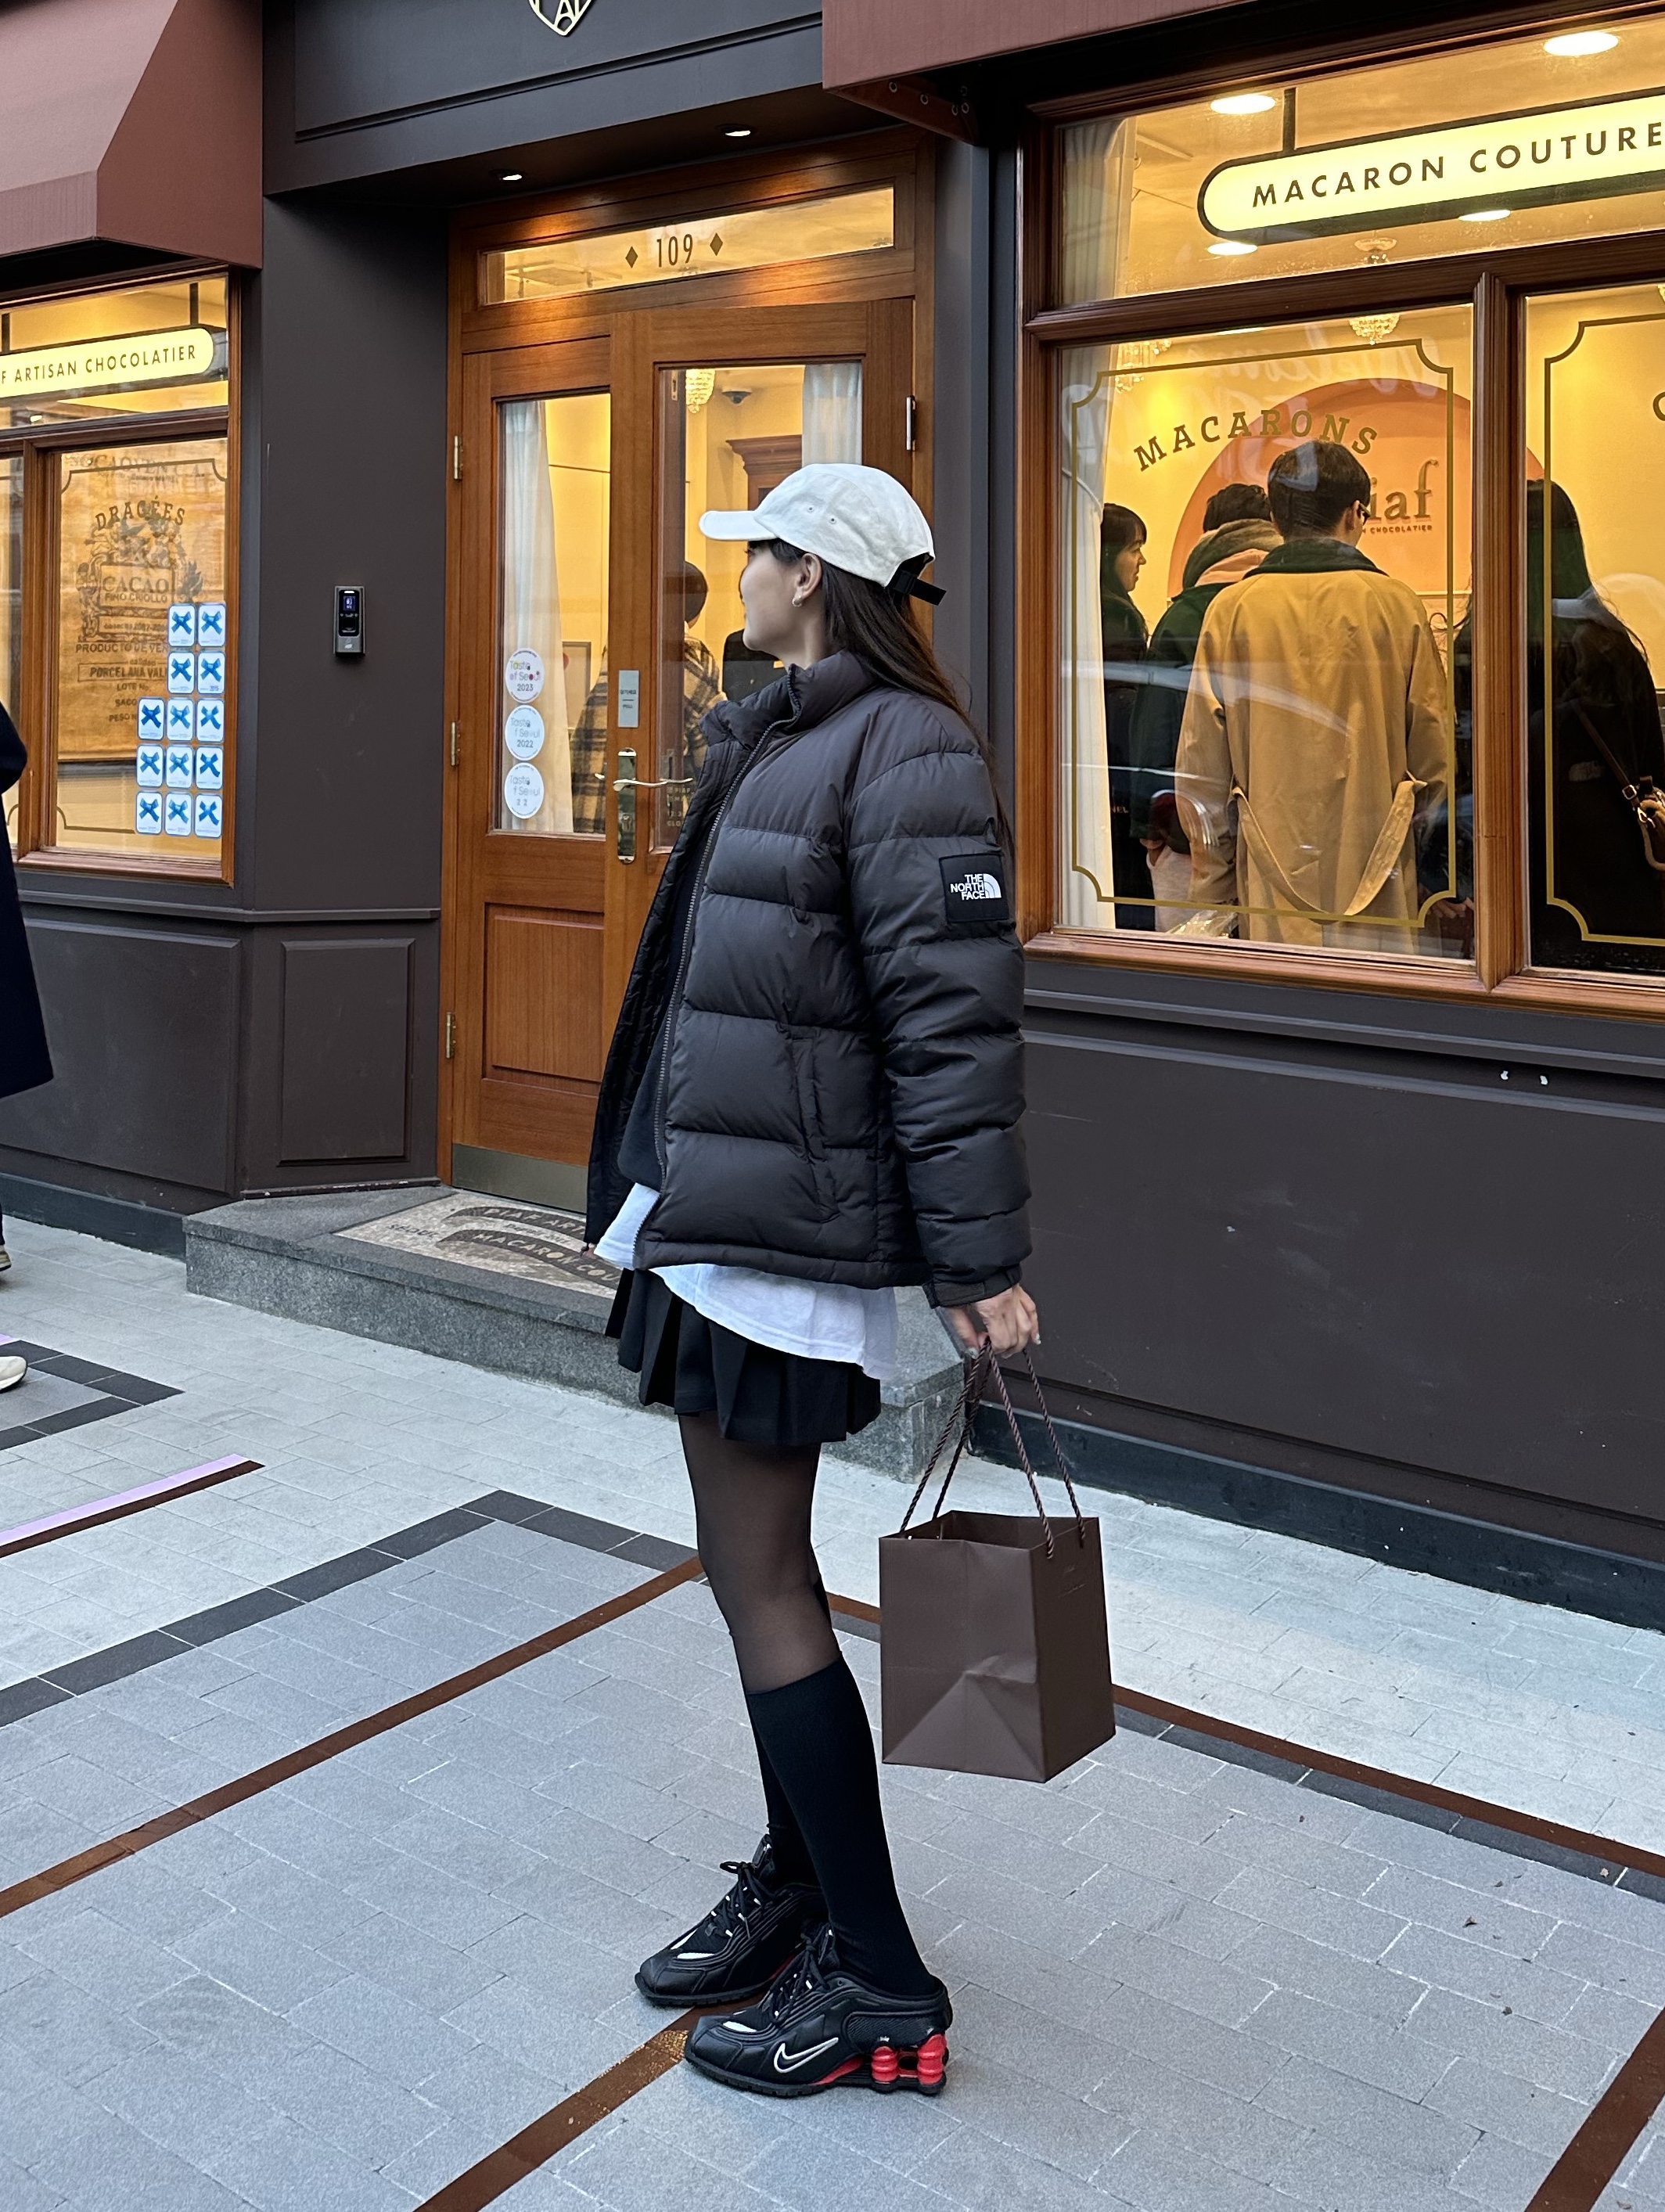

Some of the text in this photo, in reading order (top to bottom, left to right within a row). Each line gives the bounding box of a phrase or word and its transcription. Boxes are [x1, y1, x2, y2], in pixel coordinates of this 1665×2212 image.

[1252, 121, 1663, 208] MACARON COUTURE
[656, 234, 693, 268] 109
[2, 344, 196, 384] F ARTISAN CHOCOLATIER
[1133, 409, 1379, 472] MACARONS
[1368, 459, 1439, 520] iaf
[95, 495, 185, 531] DRAGÉES
[1369, 524, 1433, 534] CHOCOLATIER
[102, 576, 169, 593] CACAO
[75, 643, 132, 654] PRODUCTO
[117, 682, 136, 691] LOTE
[517, 683, 534, 692] 2023
[516, 739, 534, 748] 2022
[964, 873, 984, 883] THE
[950, 883, 984, 893] NORTH
[961, 890, 985, 901] FACE
[472, 1233, 580, 1264] MACARON
[576, 1264, 620, 1285] COU
